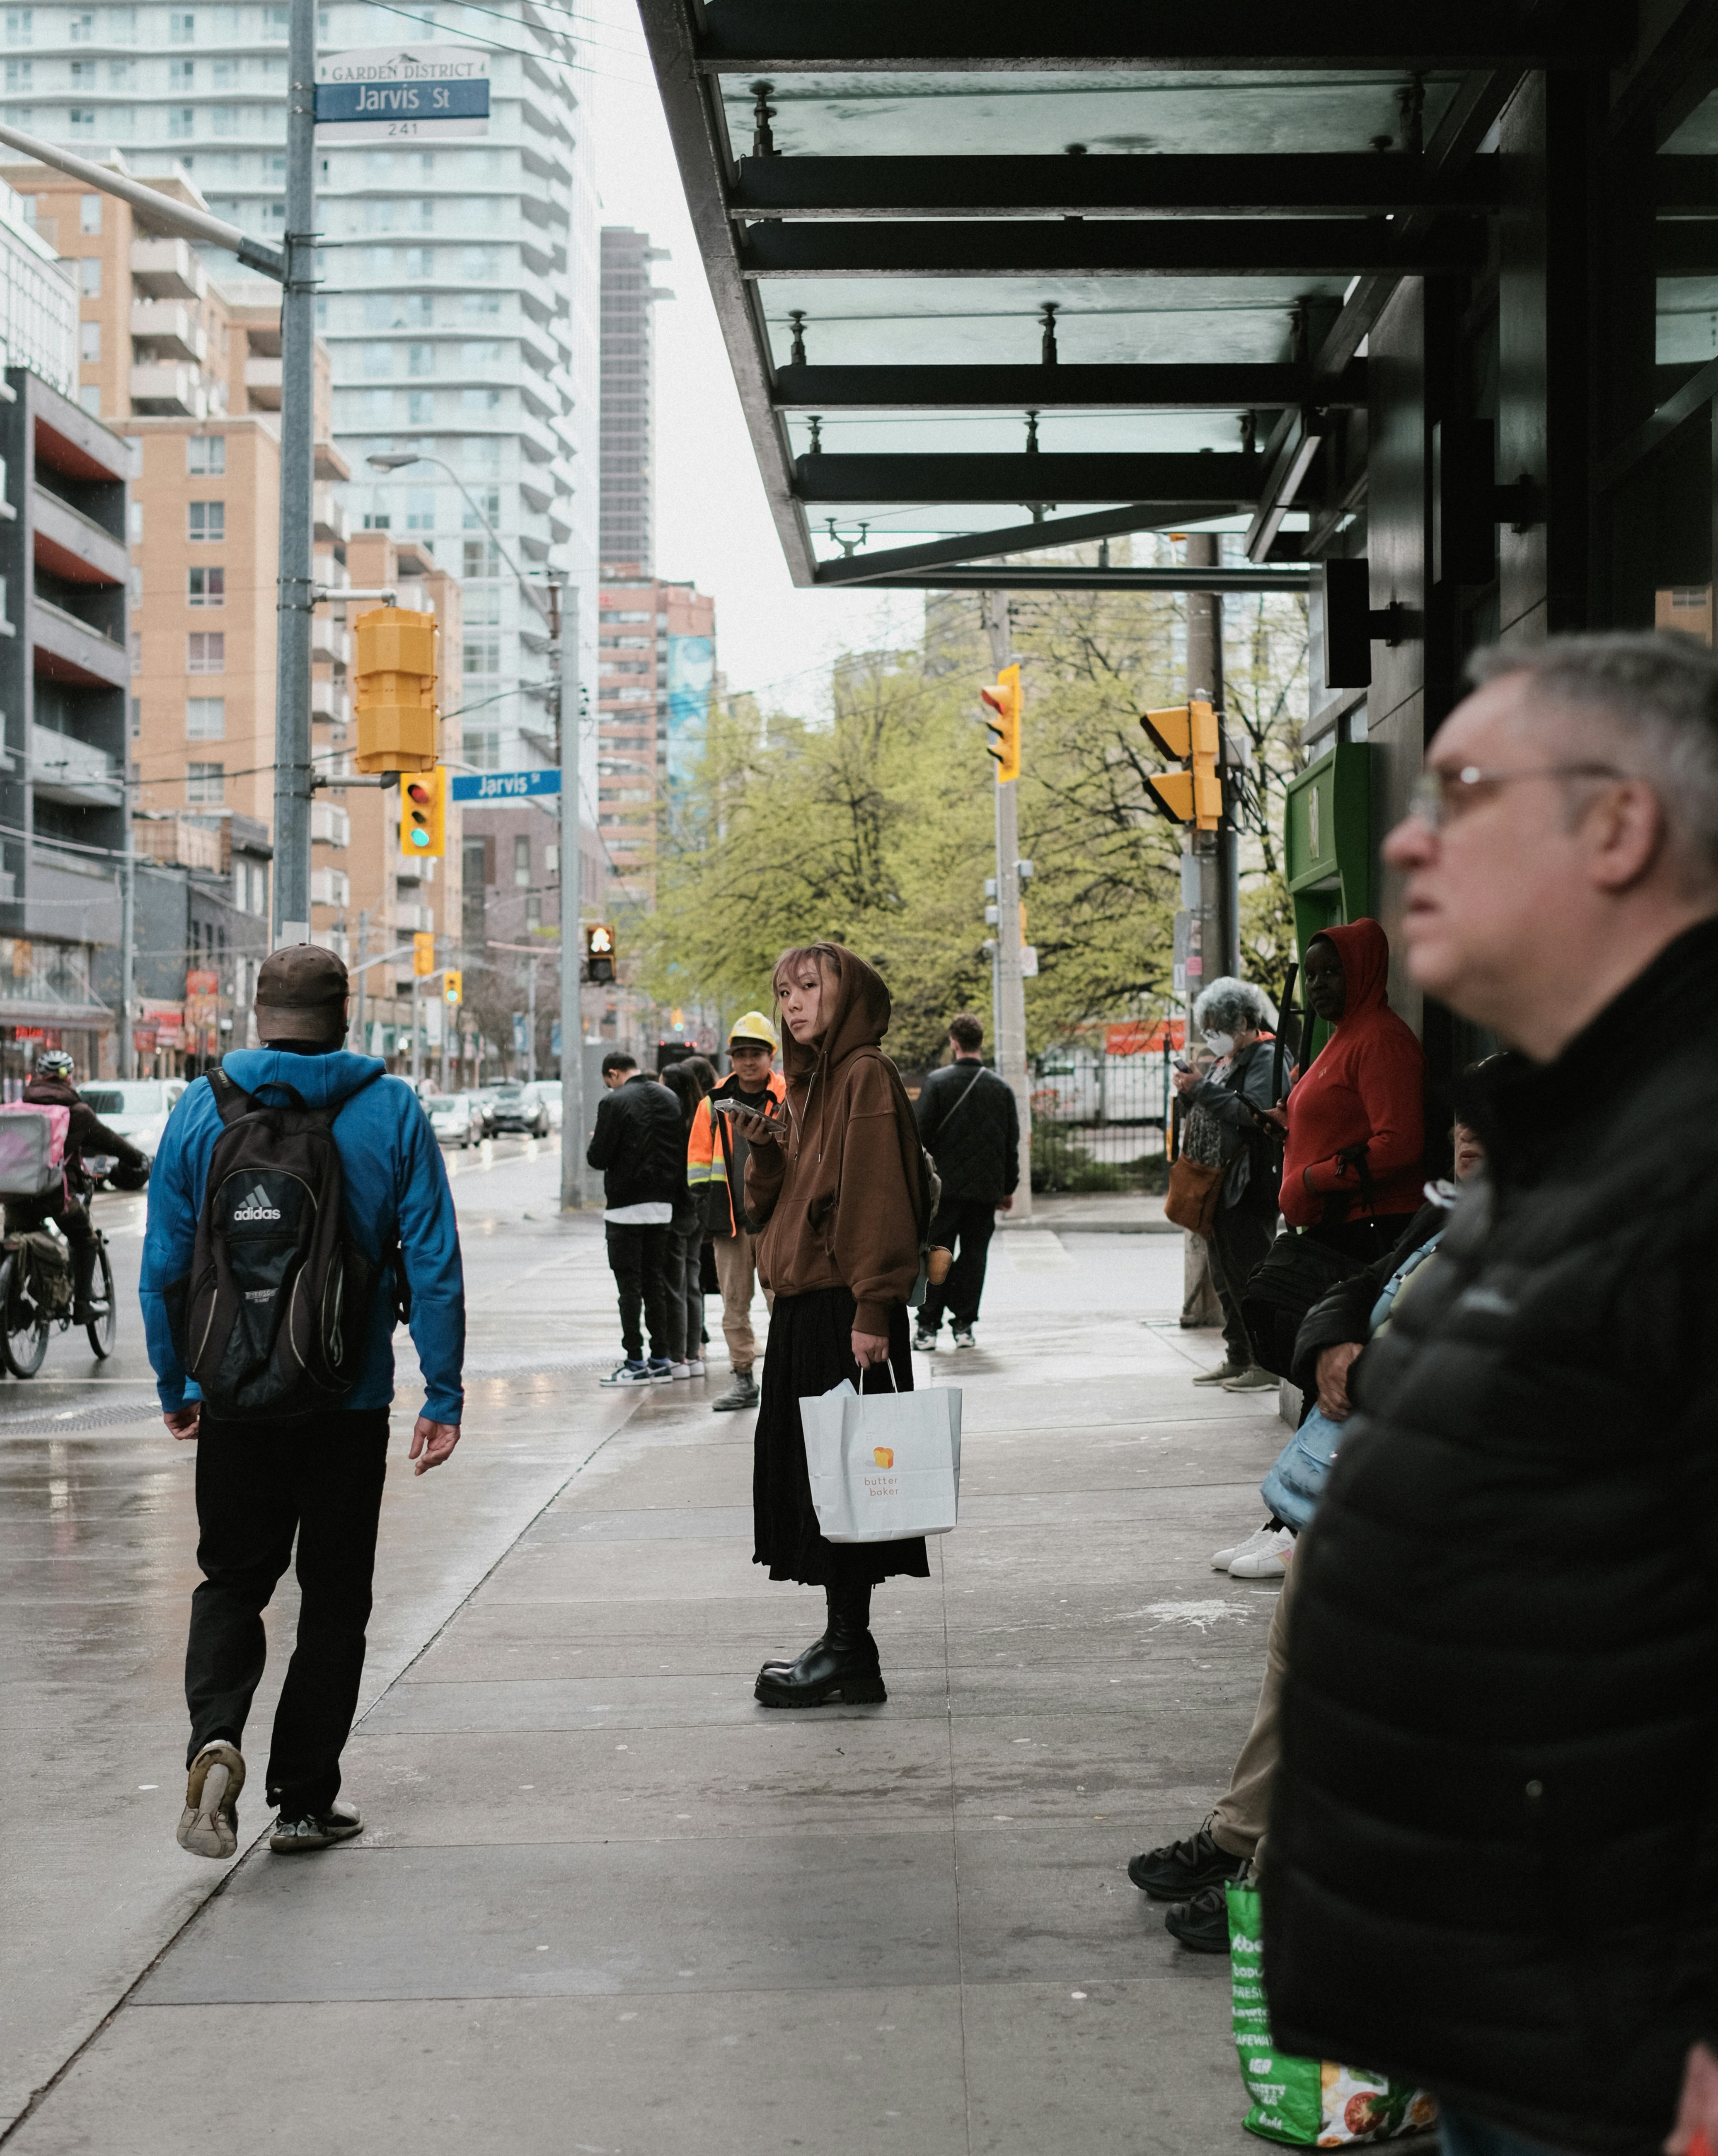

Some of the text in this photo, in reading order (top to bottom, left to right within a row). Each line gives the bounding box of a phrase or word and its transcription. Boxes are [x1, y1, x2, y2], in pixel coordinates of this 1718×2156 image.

[332, 63, 474, 80] GARDEN DISTRICT
[356, 84, 450, 111] Jarvis St
[388, 123, 418, 136] 241
[479, 773, 528, 796] Jarvis
[234, 1207, 281, 1221] adidas
[864, 1477, 898, 1486] butter
[870, 1487, 899, 1496] baker
